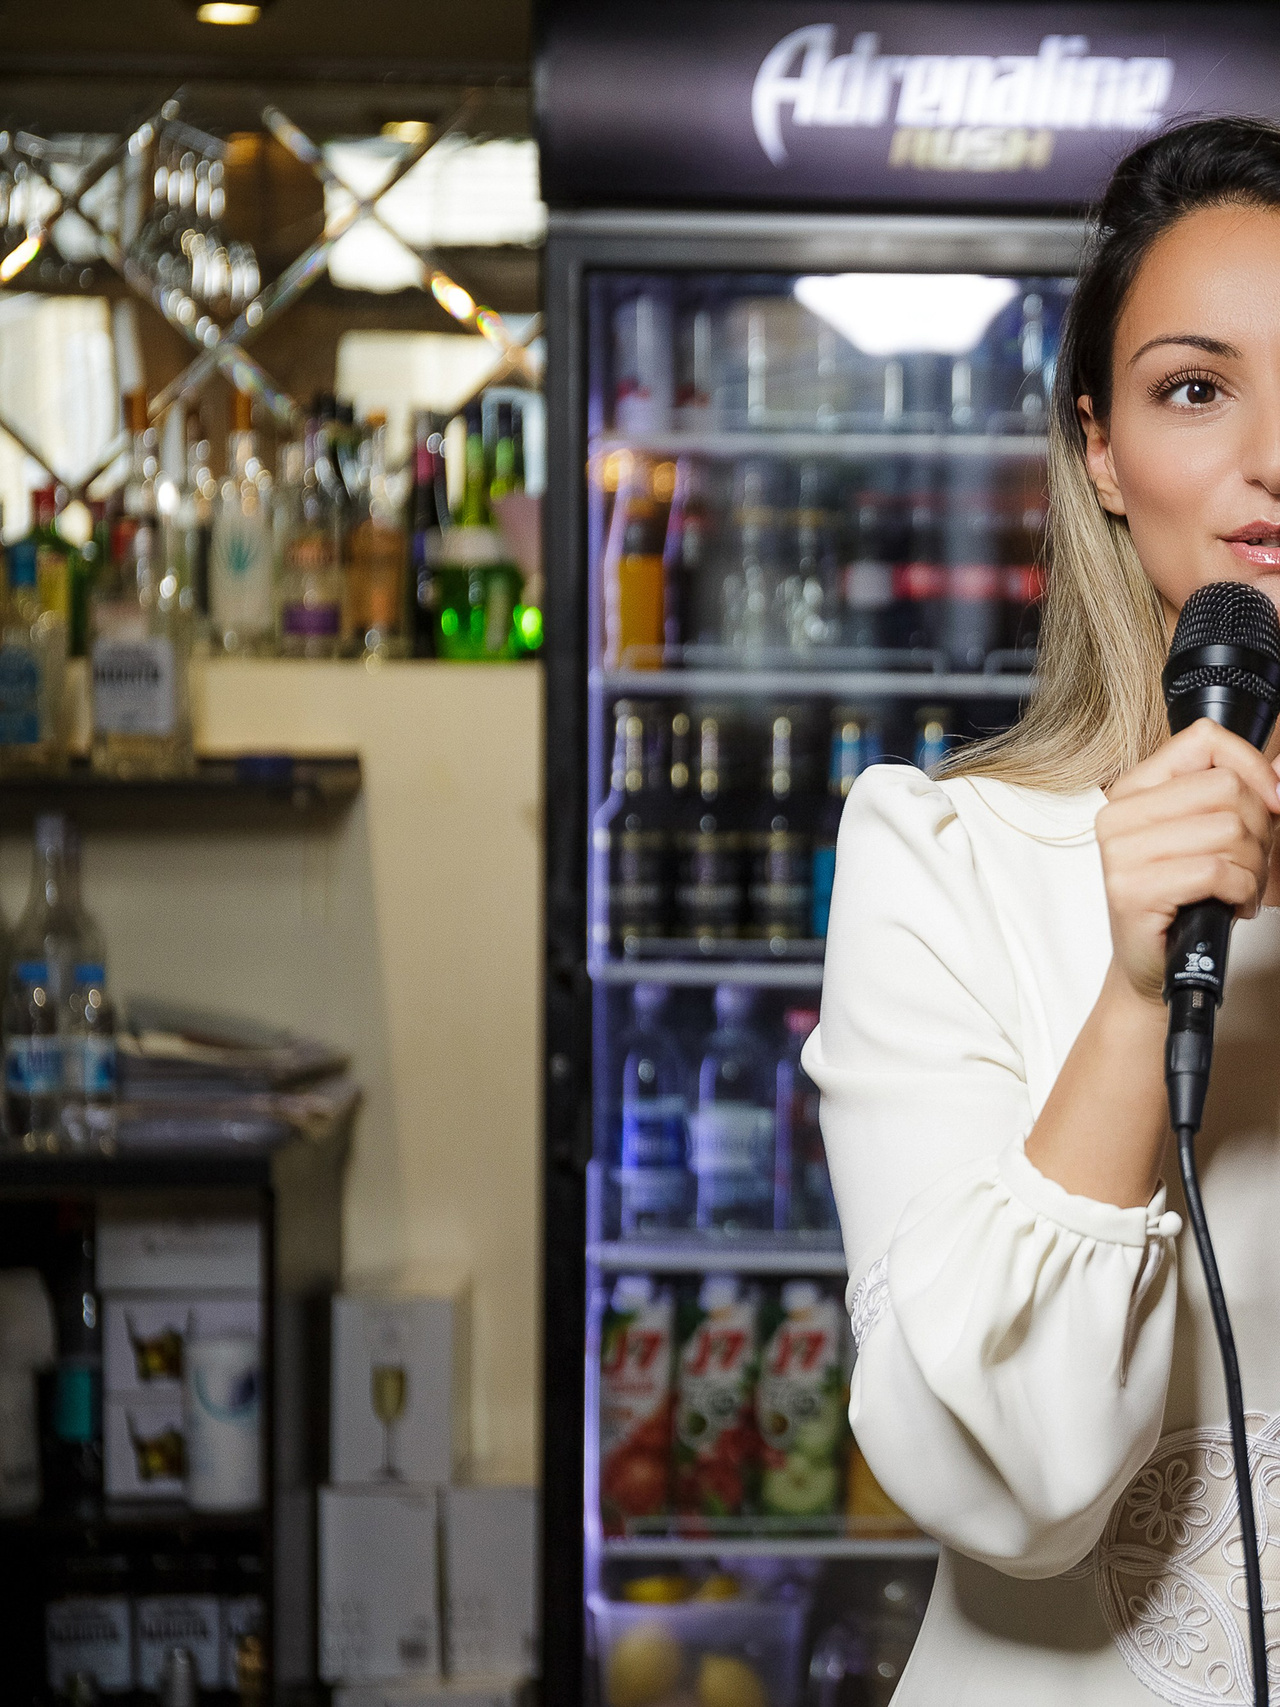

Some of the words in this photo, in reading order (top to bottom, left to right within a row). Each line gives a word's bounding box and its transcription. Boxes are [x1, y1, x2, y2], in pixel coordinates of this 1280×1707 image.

[752, 22, 1176, 168] Adrenaline
[889, 126, 1054, 171] RUSH
[685, 1330, 746, 1377] J7
[771, 1330, 827, 1377] J7
